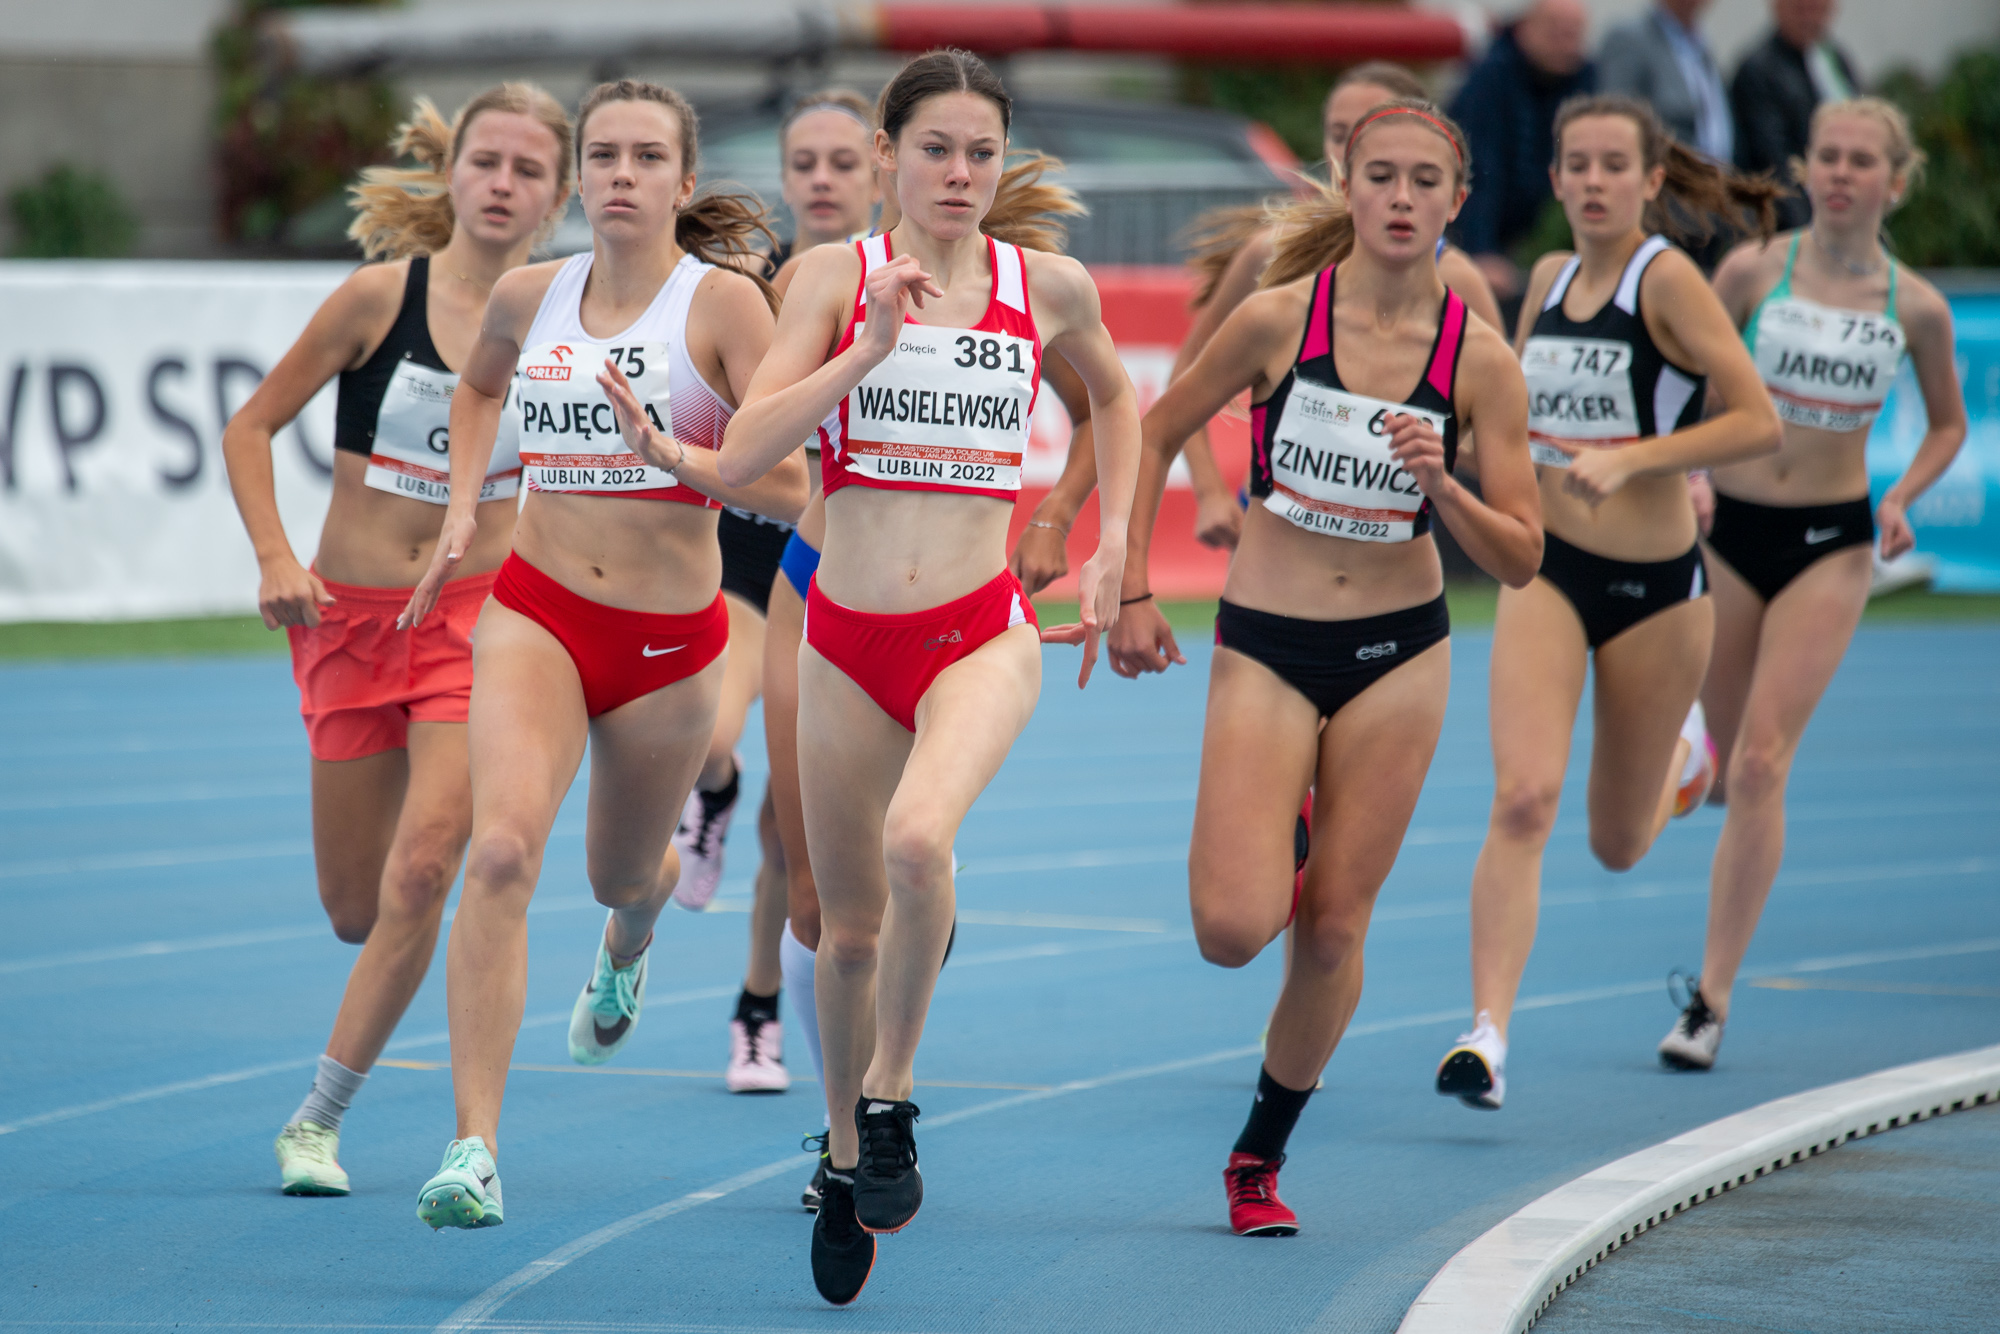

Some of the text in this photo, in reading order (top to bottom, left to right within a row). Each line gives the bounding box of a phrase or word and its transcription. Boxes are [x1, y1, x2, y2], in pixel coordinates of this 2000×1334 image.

[609, 346, 645, 378] 75
[899, 342, 937, 355] Okęcie
[954, 335, 1025, 374] 381
[1570, 345, 1622, 377] 747
[527, 366, 569, 380] ORLEN
[524, 400, 666, 441] PAJĘCA
[857, 385, 1021, 431] WASIELEWSKA
[541, 468, 646, 485] LUBLIN 2022
[878, 458, 995, 482] LUBLIN 2022
[1276, 438, 1421, 497] ZINIEWICZ
[1286, 504, 1344, 532] LUBLIN
[1347, 520, 1390, 537] 2022
[1355, 640, 1398, 660] esa
